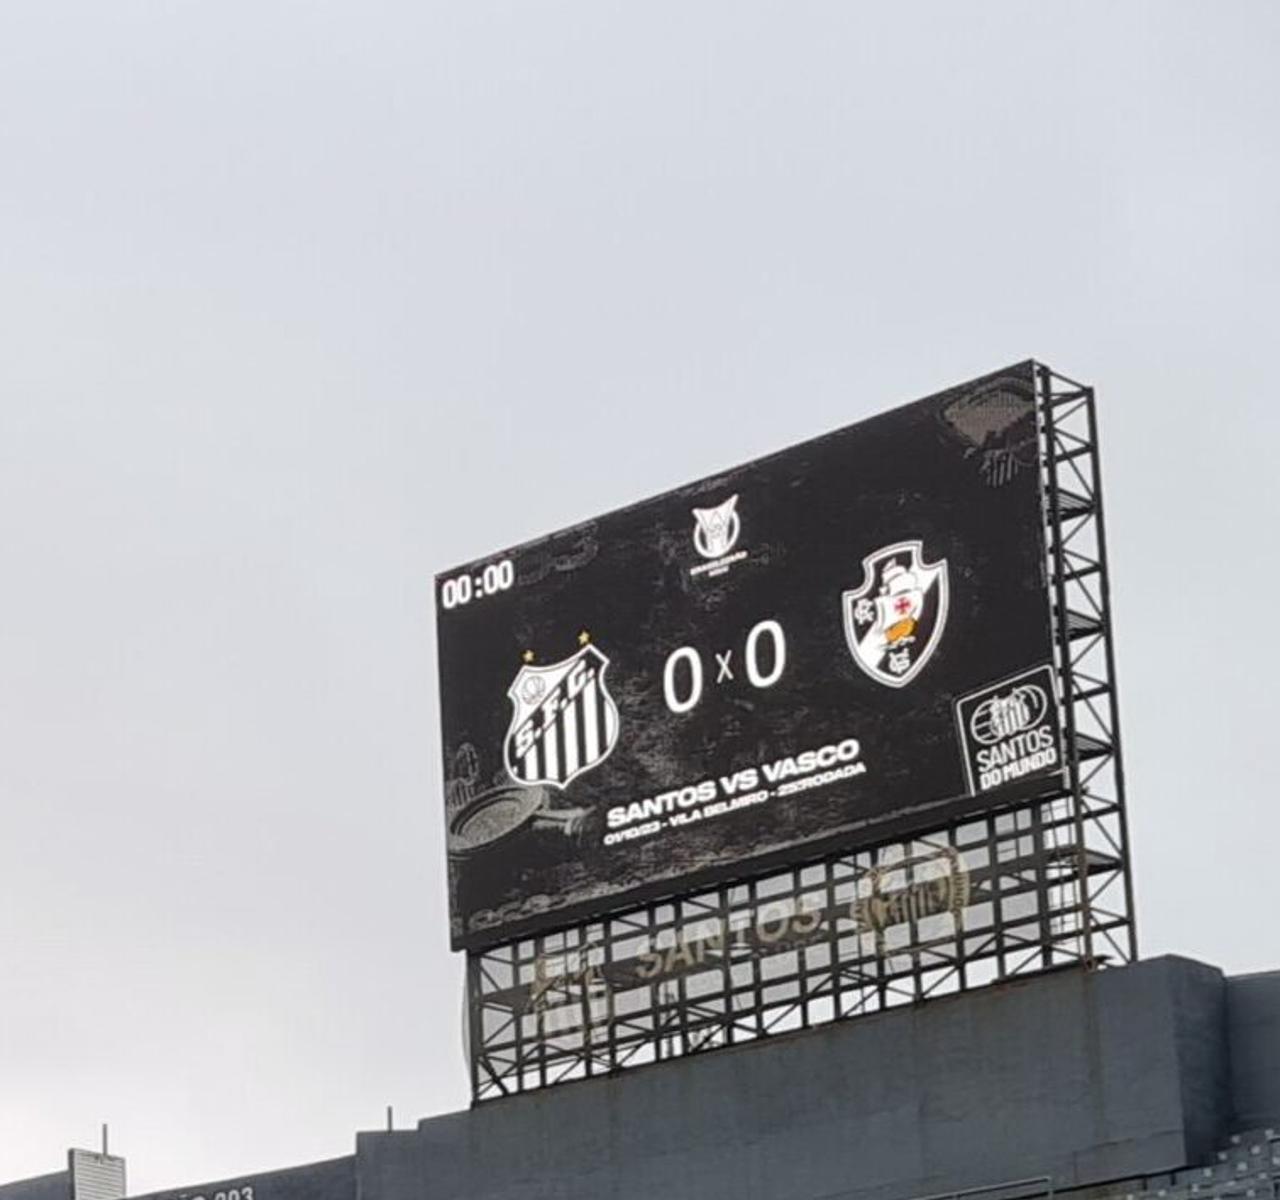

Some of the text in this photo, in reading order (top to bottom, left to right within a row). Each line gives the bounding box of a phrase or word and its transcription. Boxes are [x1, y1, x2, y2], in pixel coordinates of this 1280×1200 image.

[442, 560, 514, 609] 00:00
[663, 645, 703, 714] 0
[745, 619, 787, 688] 0
[976, 725, 1055, 773] SANTOS
[980, 747, 1058, 791] DO MUNDO
[607, 738, 860, 828] SANTOS VS VASCO
